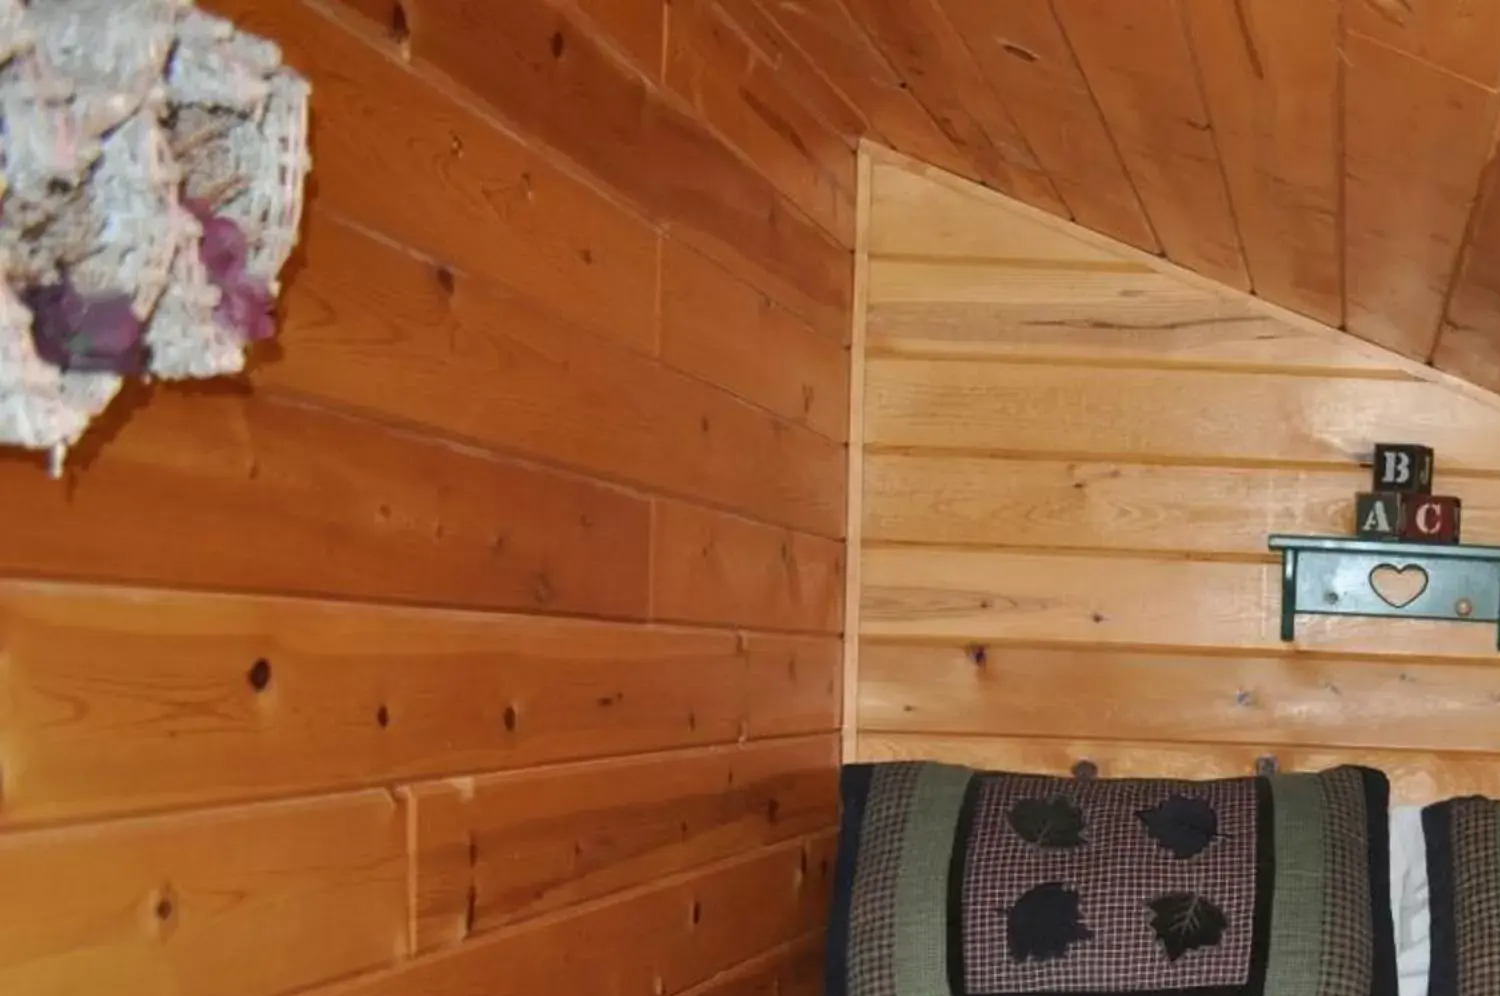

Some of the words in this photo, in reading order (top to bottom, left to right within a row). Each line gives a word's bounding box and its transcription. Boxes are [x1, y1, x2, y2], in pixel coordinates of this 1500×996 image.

[1382, 451, 1411, 483] B
[1362, 500, 1391, 532] A
[1416, 503, 1442, 534] C
